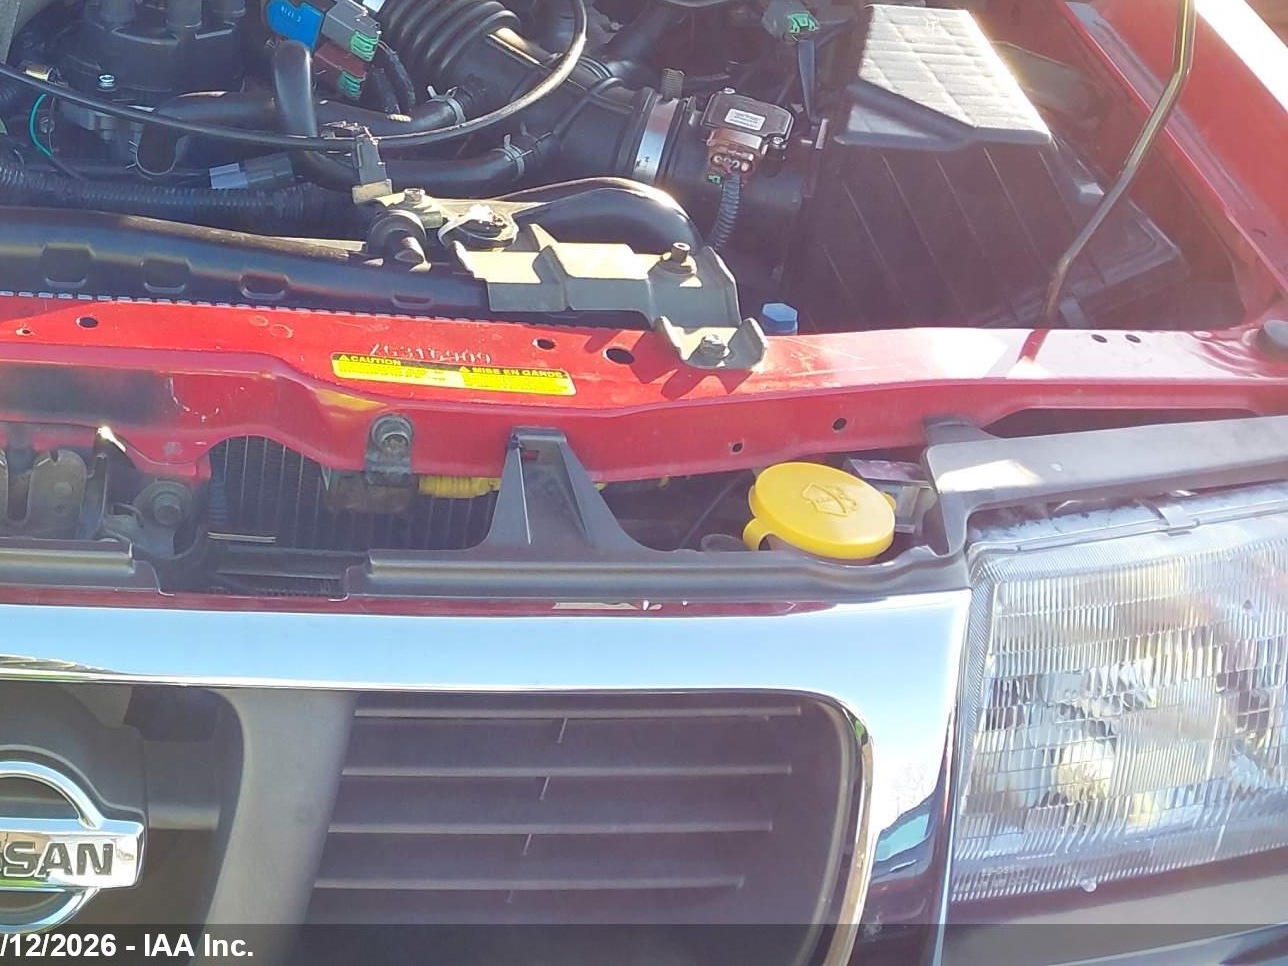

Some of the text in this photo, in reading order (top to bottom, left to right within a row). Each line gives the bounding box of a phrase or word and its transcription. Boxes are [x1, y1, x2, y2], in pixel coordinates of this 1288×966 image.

[349, 355, 401, 366] CAUTION
[472, 366, 564, 378] MISE EN GARDE
